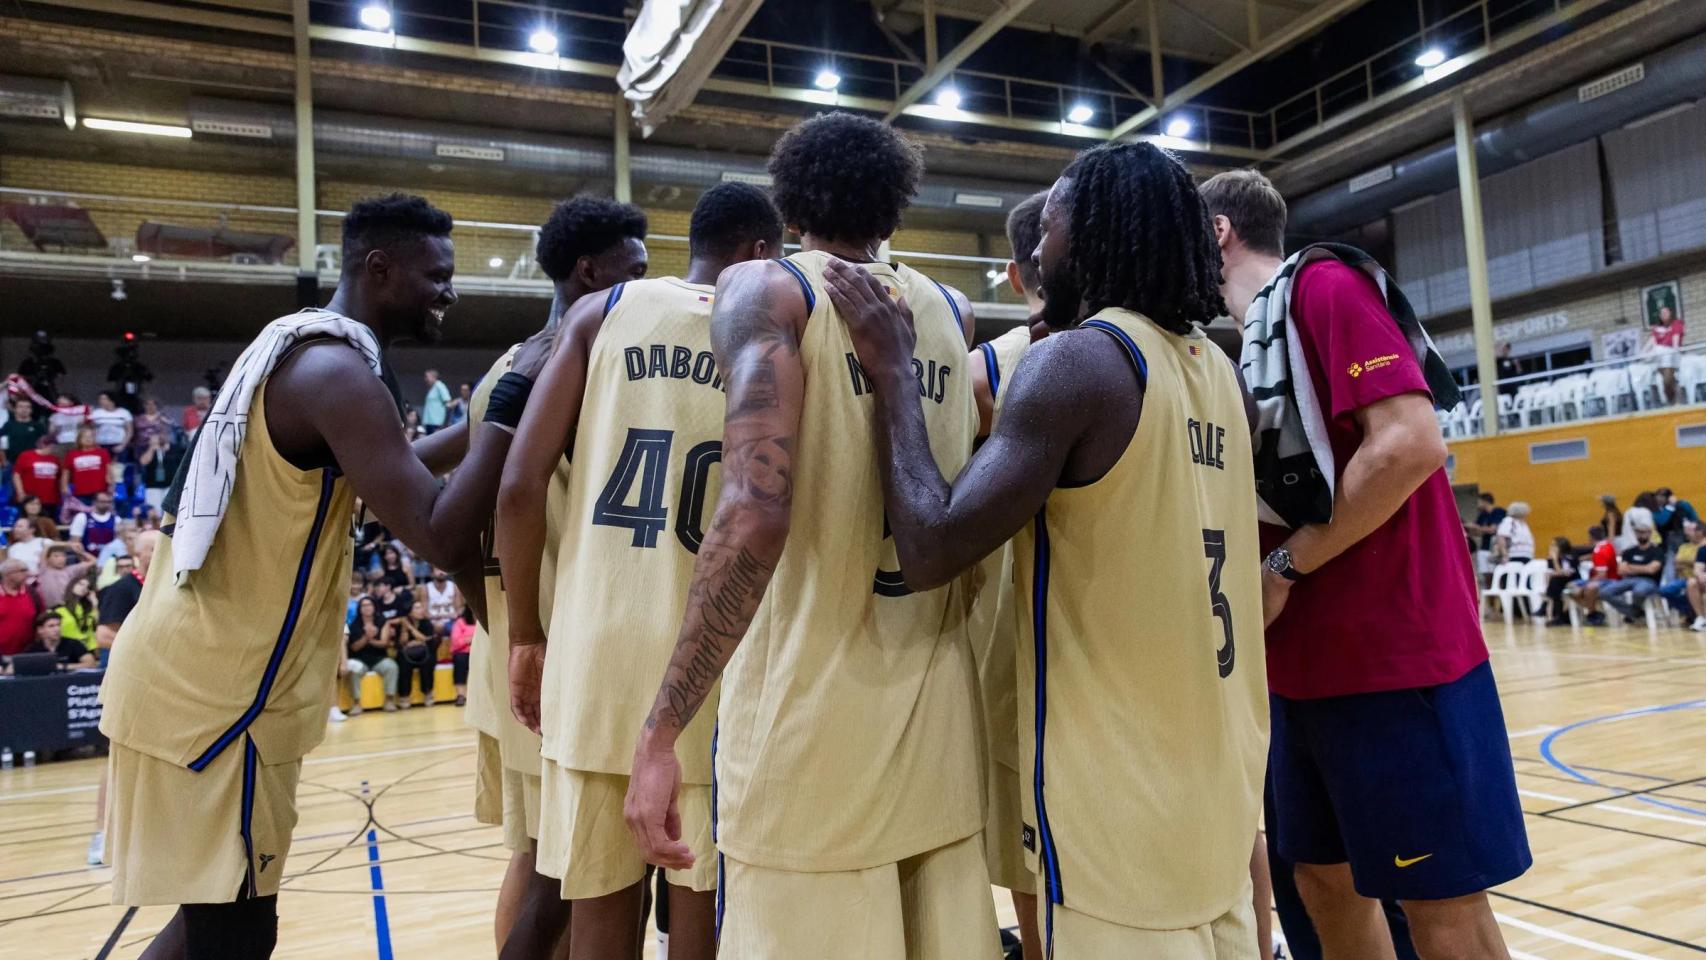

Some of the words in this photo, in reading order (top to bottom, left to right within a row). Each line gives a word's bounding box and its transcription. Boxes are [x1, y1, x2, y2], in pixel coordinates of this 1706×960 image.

[845, 352, 951, 404] NRIS
[592, 428, 722, 555] 40
[1202, 529, 1235, 679] 3
